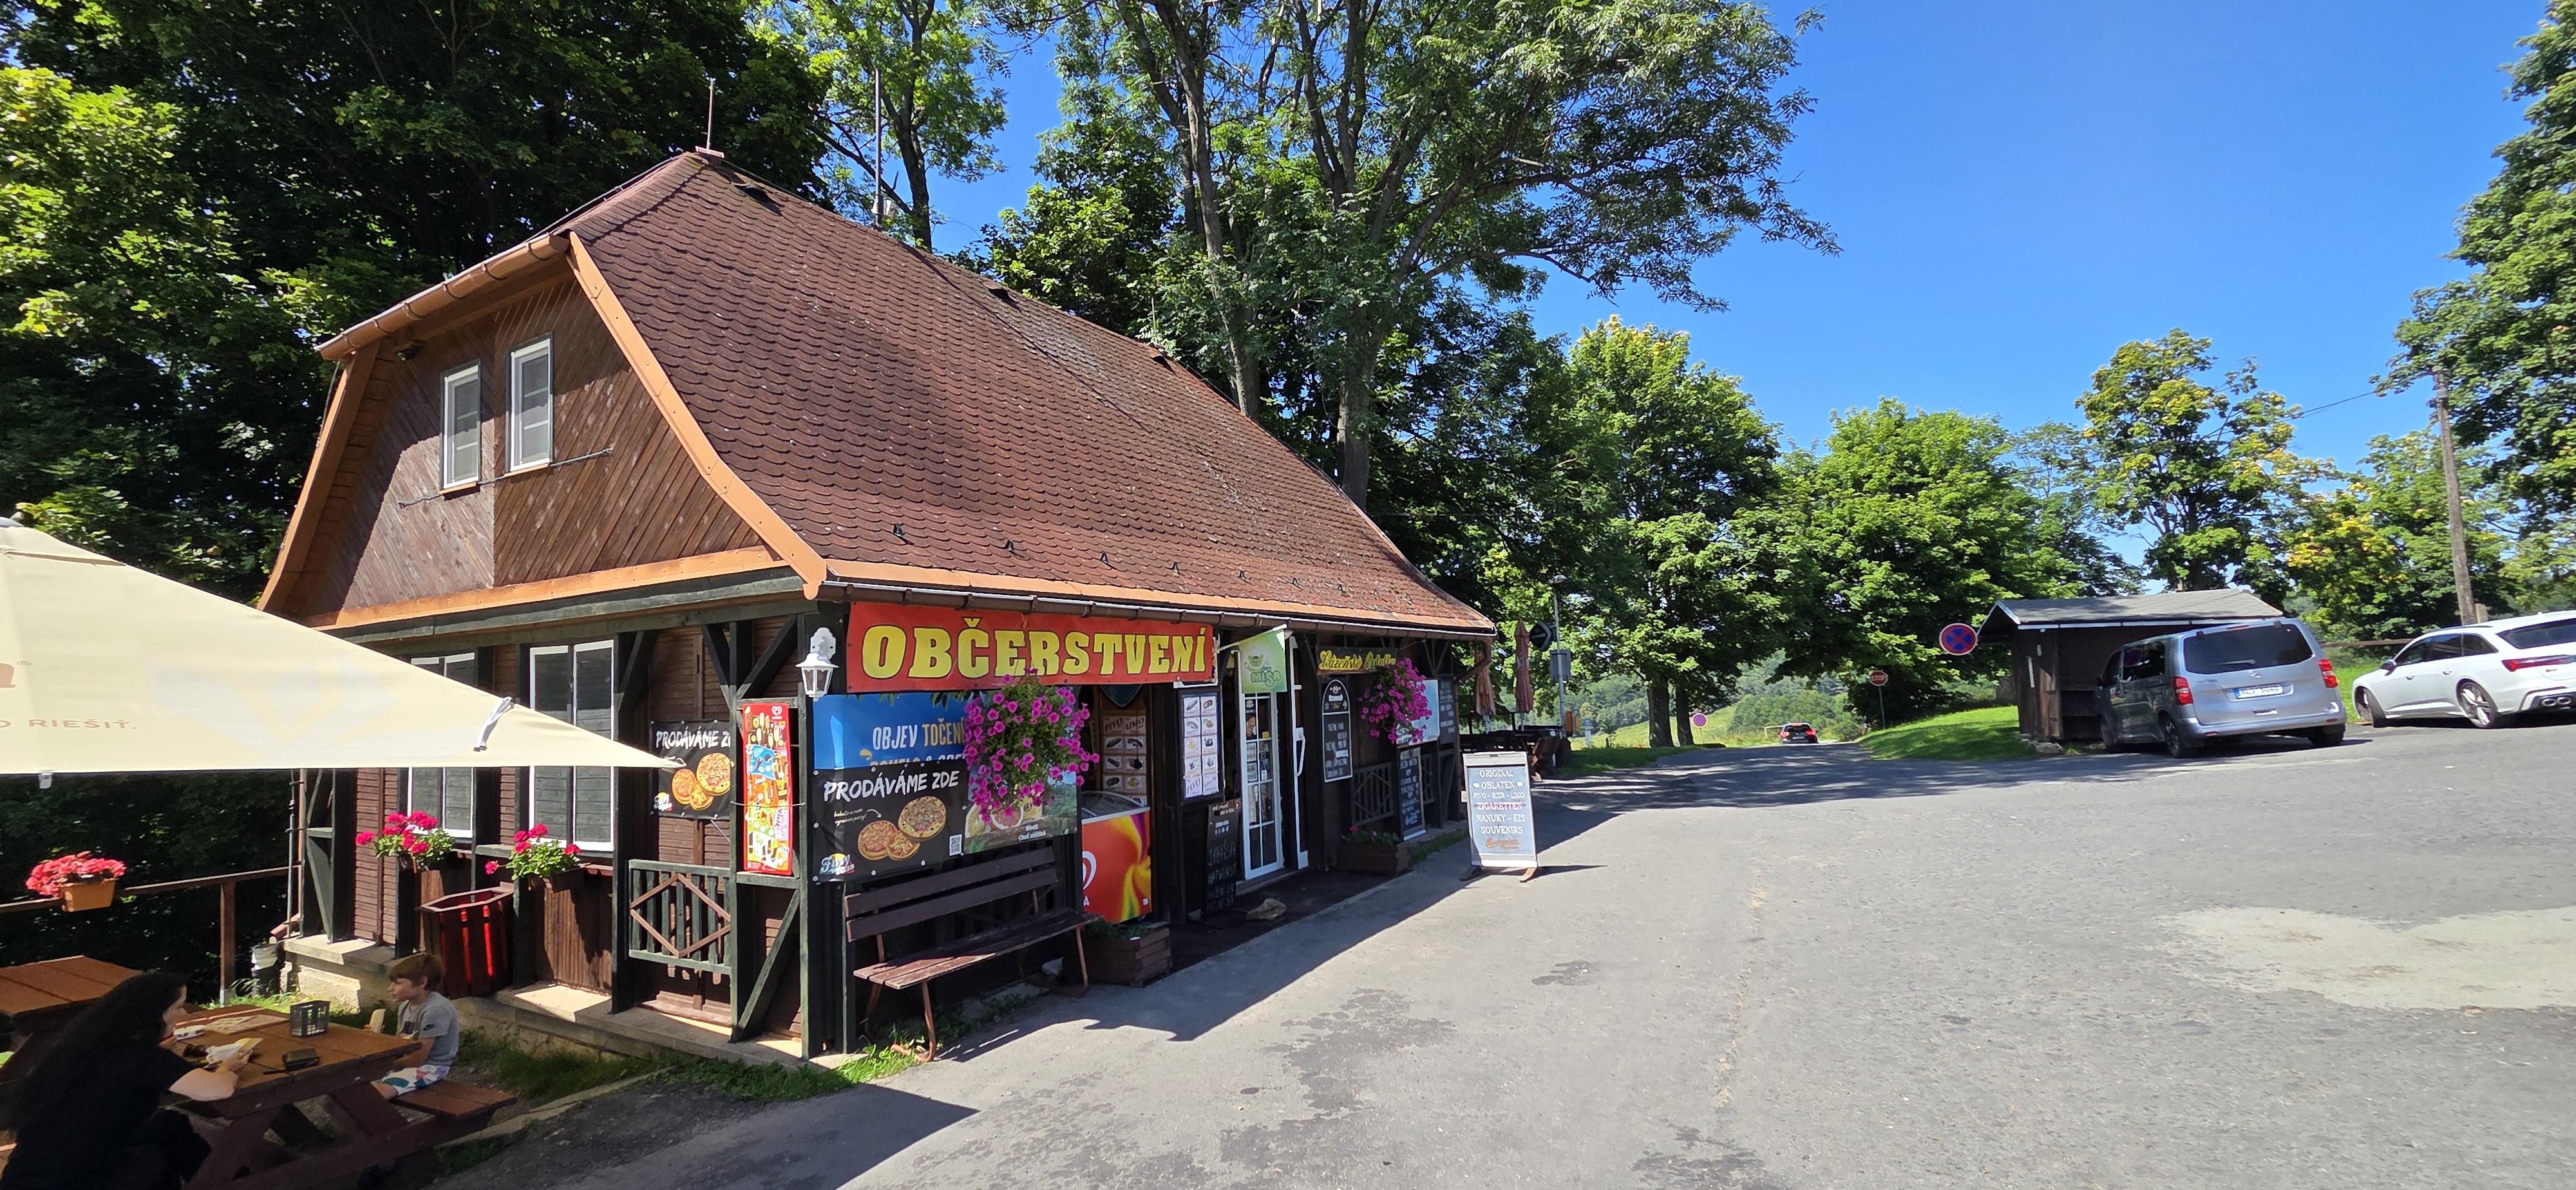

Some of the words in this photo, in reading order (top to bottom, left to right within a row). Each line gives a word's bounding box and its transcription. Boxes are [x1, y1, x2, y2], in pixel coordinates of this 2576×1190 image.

[862, 617, 1206, 679] OBČERSTVENÍ
[28, 718, 137, 729] RIEŠIŤ.
[656, 726, 719, 750] PRODÁVÁME
[721, 731, 731, 747] Z
[873, 724, 918, 750] OBJEV
[1479, 769, 1514, 778] ORIGINAL
[824, 770, 928, 802] PRODÁVÁME
[932, 771, 960, 789] ZDE
[1481, 780, 1514, 789] OBLATEN
[1477, 802, 1522, 811] ZIGARETTEN
[1476, 814, 1506, 822] NANUKY
[1513, 814, 1526, 822] EIS
[1481, 826, 1524, 835] SOUVENIRS
